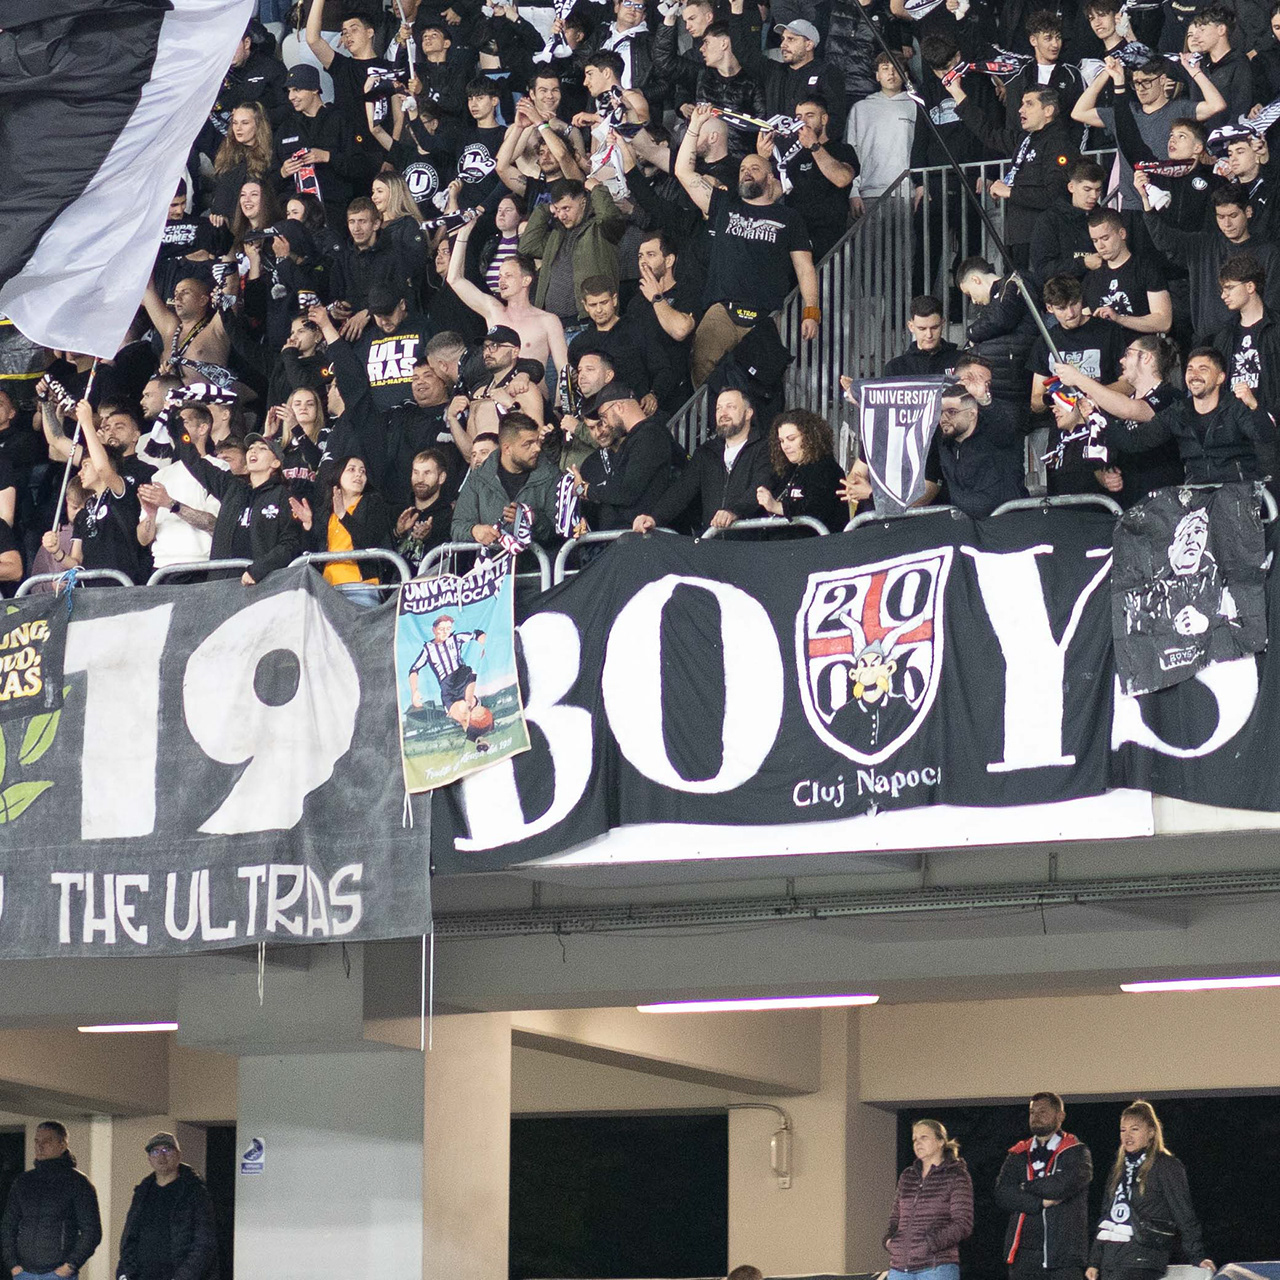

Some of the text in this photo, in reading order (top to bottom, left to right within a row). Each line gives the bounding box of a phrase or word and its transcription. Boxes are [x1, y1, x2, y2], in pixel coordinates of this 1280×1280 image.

[369, 339, 419, 361] ULT
[368, 357, 417, 382] RAS
[370, 377, 414, 388] CLUJ-NAPOC
[61, 587, 360, 841] 19
[792, 775, 845, 808] Cluj
[51, 862, 365, 944] THE ULTRAS
